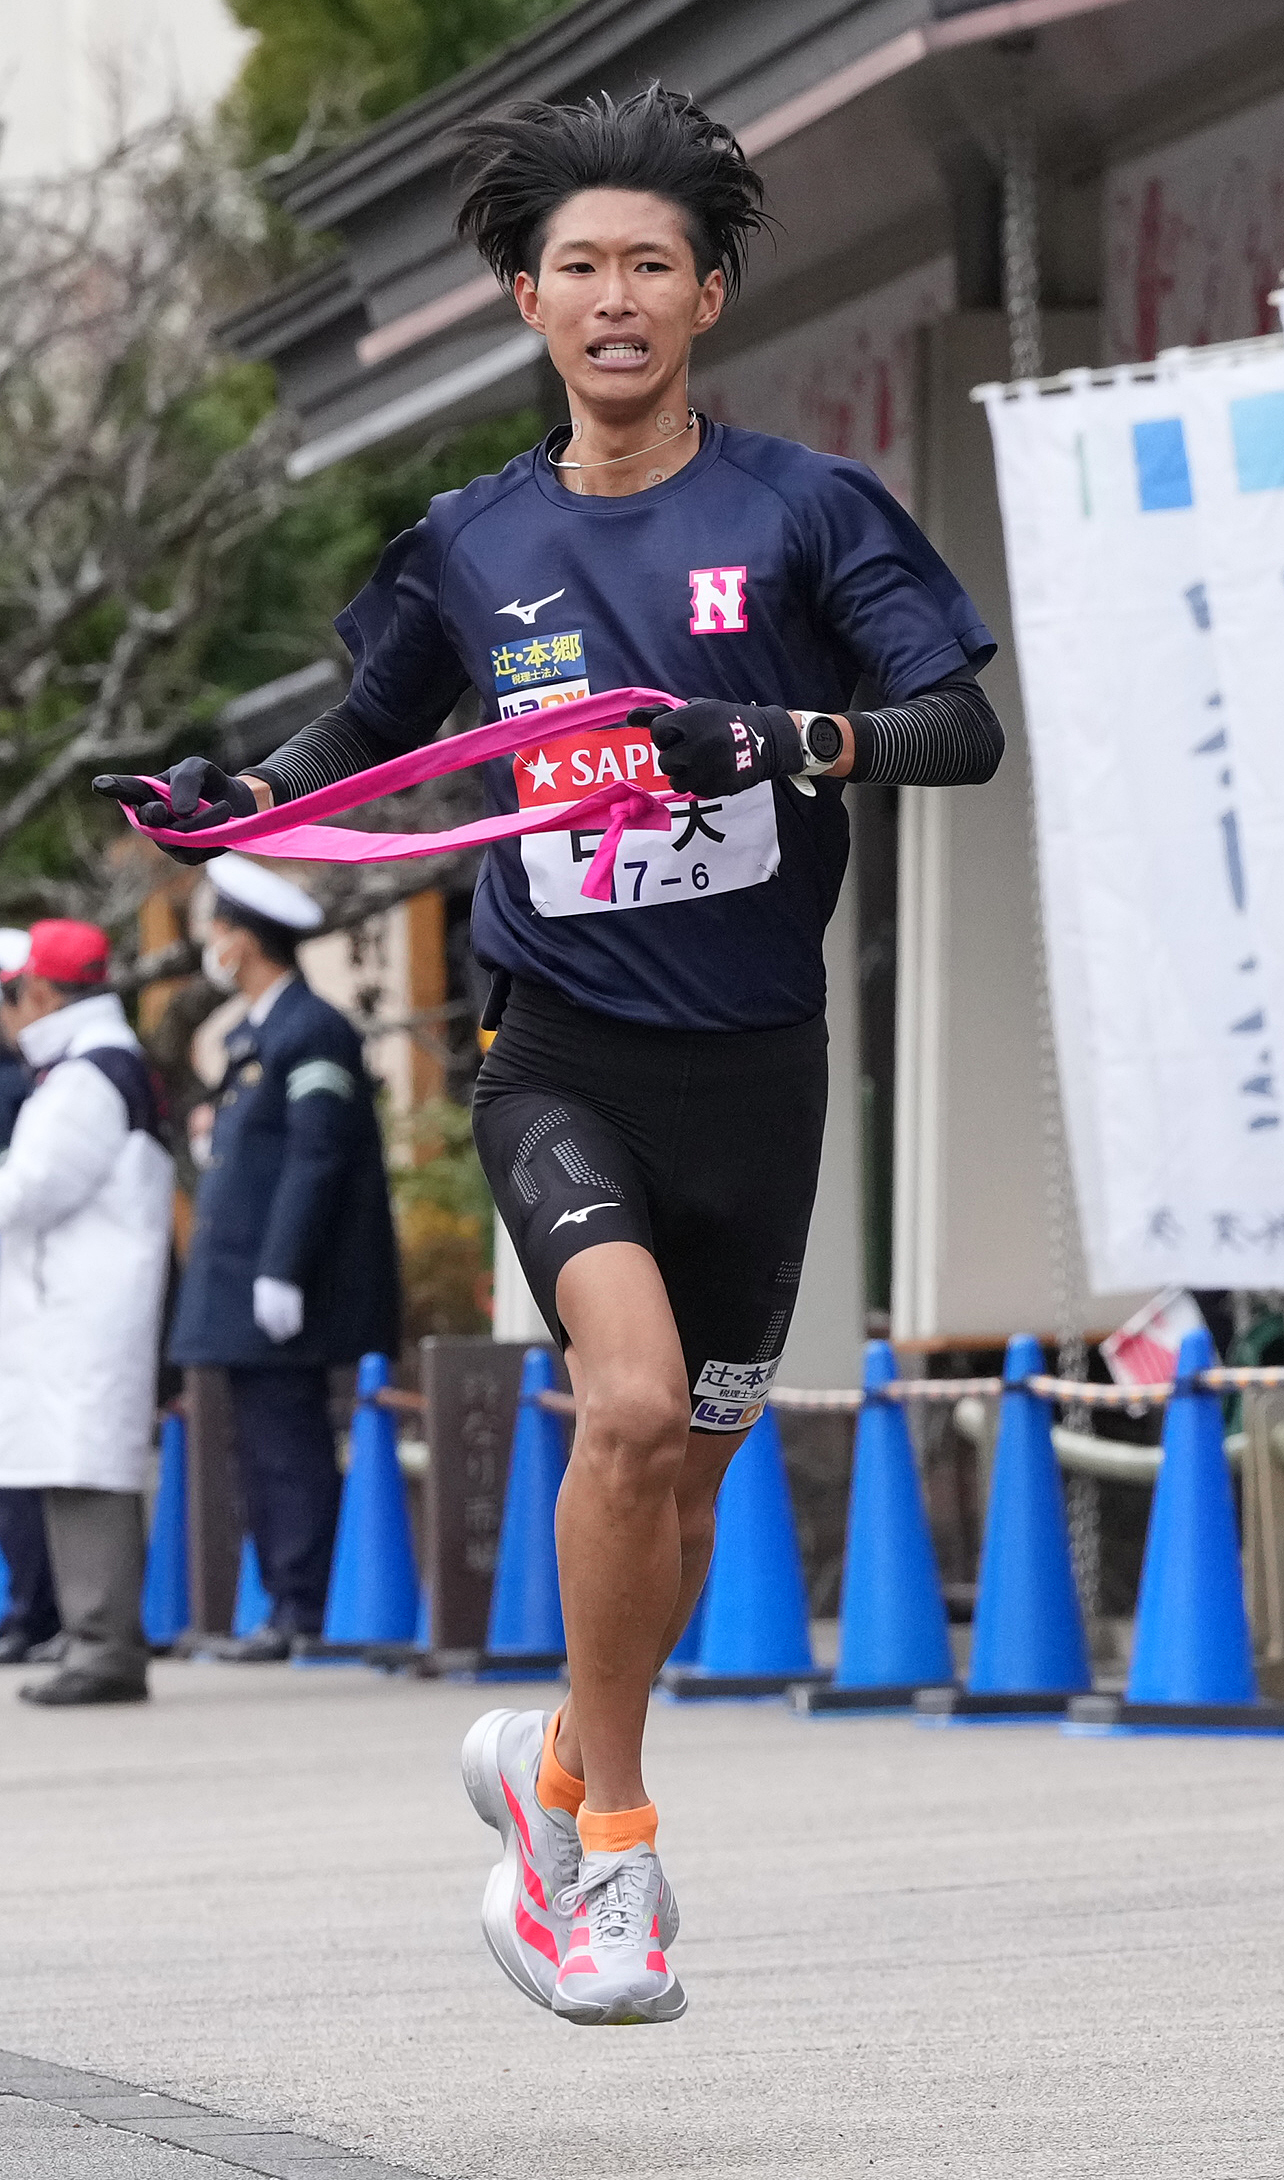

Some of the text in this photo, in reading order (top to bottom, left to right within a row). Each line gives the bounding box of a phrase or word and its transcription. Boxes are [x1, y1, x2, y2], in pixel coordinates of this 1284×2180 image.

[690, 567, 747, 634] N
[491, 634, 582, 677] 辻・本郷
[511, 666, 562, 685] 税理士法人
[610, 861, 710, 904] 7-6
